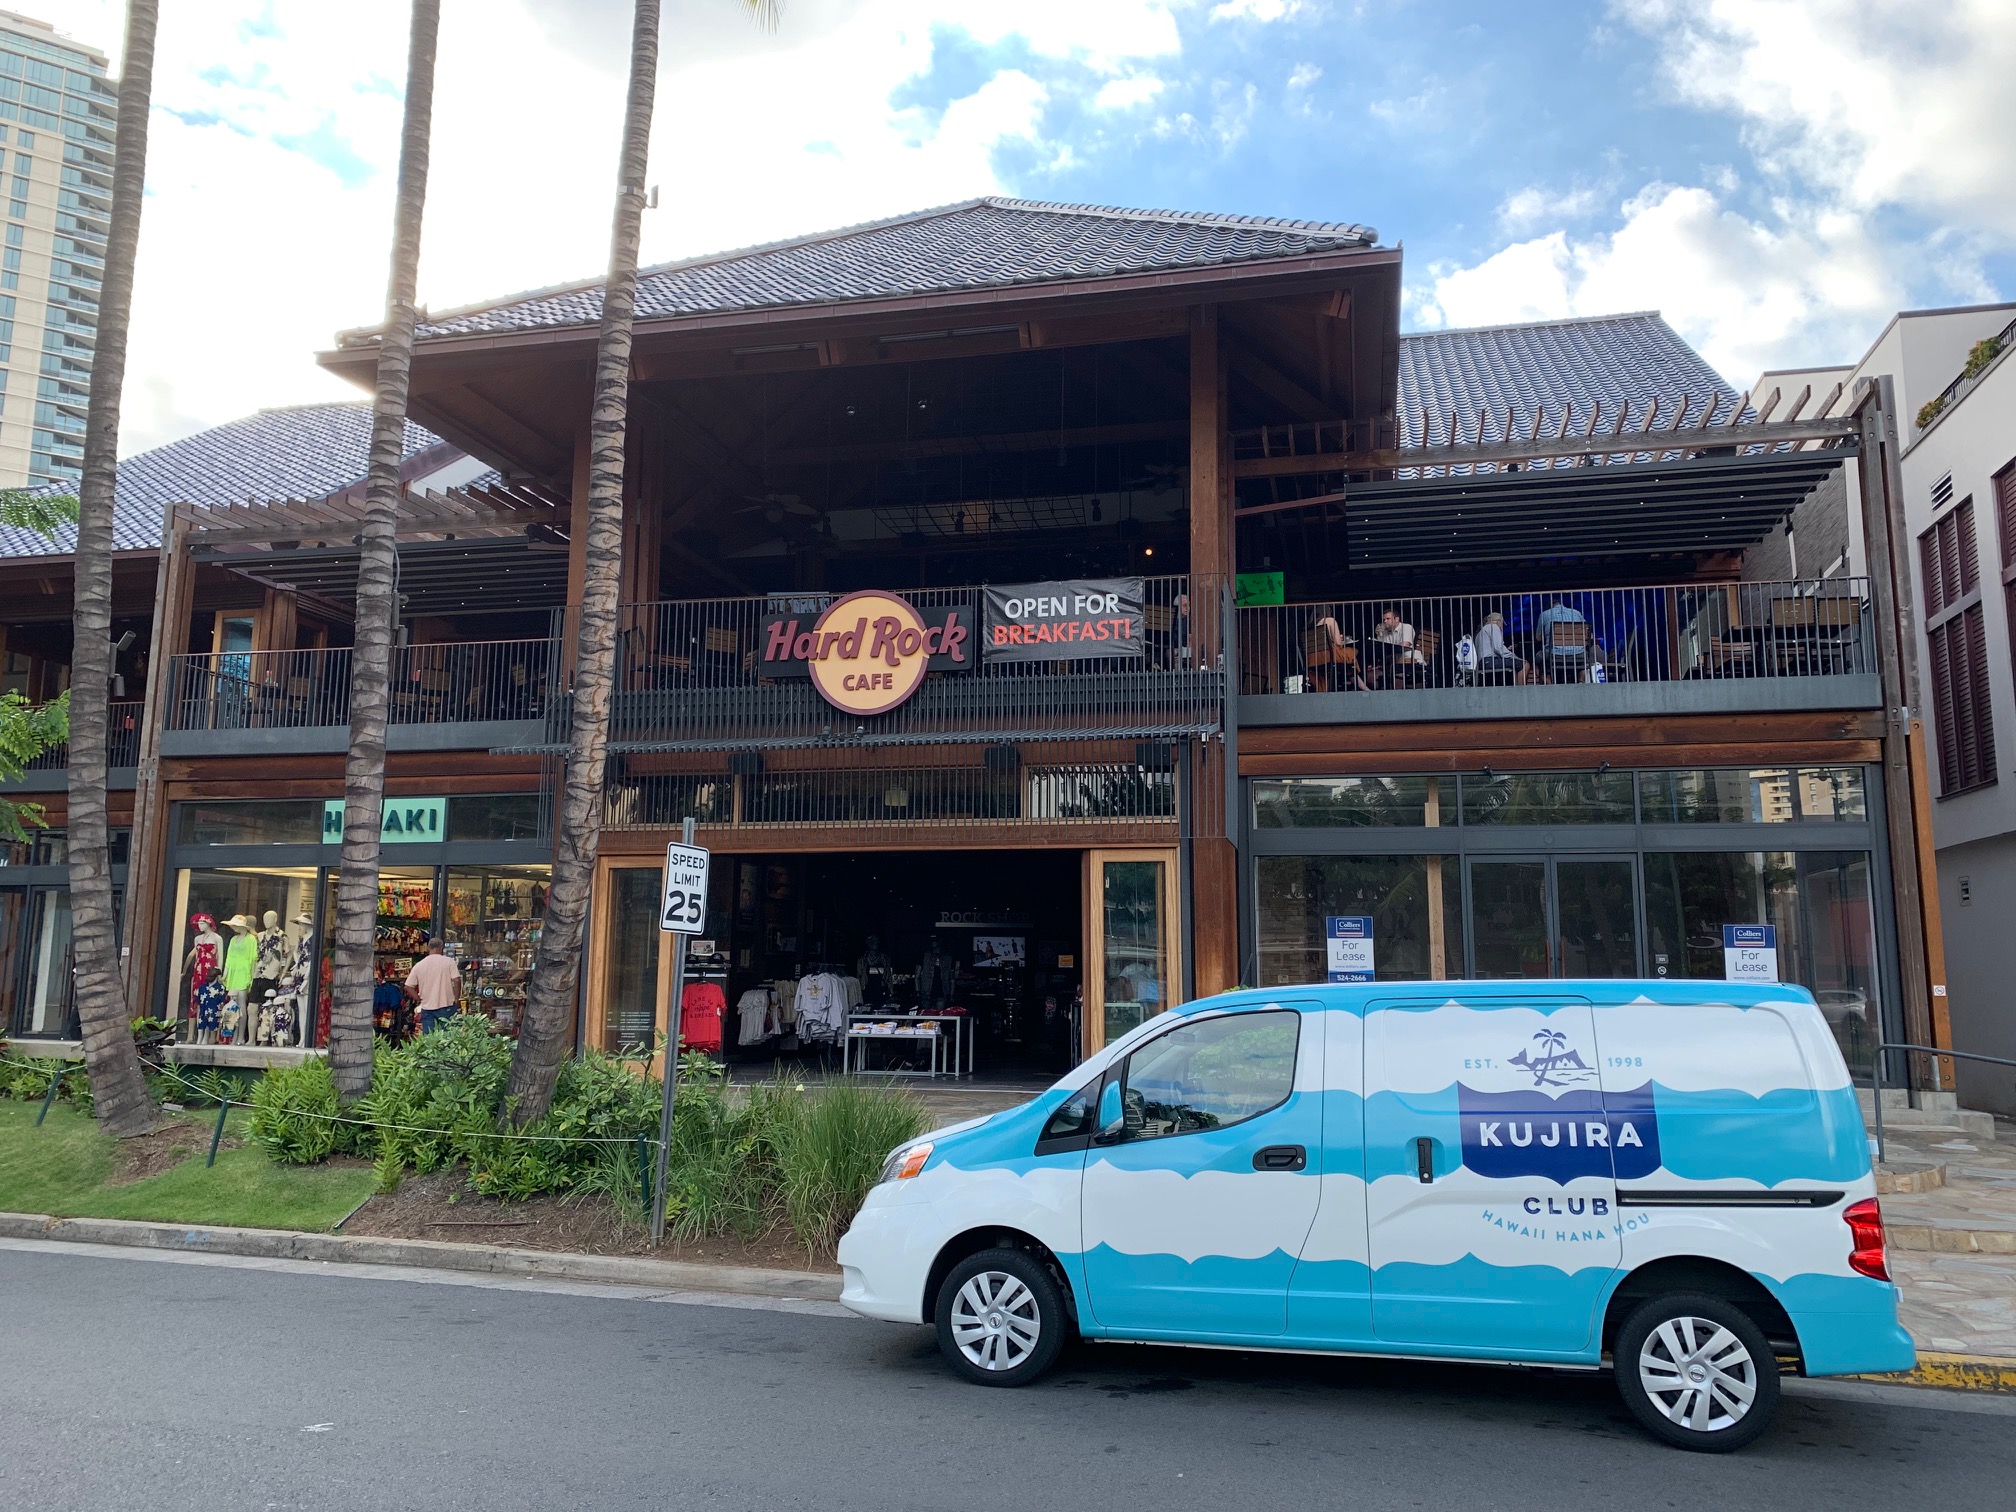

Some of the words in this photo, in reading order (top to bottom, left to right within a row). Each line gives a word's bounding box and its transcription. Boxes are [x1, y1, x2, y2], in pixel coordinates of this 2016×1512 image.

[1004, 596, 1067, 619] OPEN
[1074, 593, 1120, 615] FOR
[764, 617, 868, 662] Hard
[870, 613, 968, 666] Rock
[993, 618, 1131, 646] BREAKFAST!
[843, 673, 893, 691] CAFE
[324, 809, 437, 833] HAKI
[672, 853, 706, 870] SPEED
[674, 872, 701, 887] LIMIT
[665, 890, 702, 924] 25
[940, 911, 982, 923] ROCK
[1342, 940, 1359, 950] For
[1336, 951, 1366, 961] Lease
[1741, 949, 1760, 960] For
[1735, 961, 1768, 972] Lease
[1336, 974, 1367, 982] 524-2666
[1464, 1058, 1498, 1069] EST.
[1607, 1057, 1643, 1068] 1998
[1479, 1122, 1644, 1148] KUJIRA
[1523, 1197, 1609, 1216] CLUB
[1482, 1210, 1546, 1240] HAWAII
[1556, 1230, 1606, 1242] HANA
[1613, 1213, 1650, 1236] HOU
